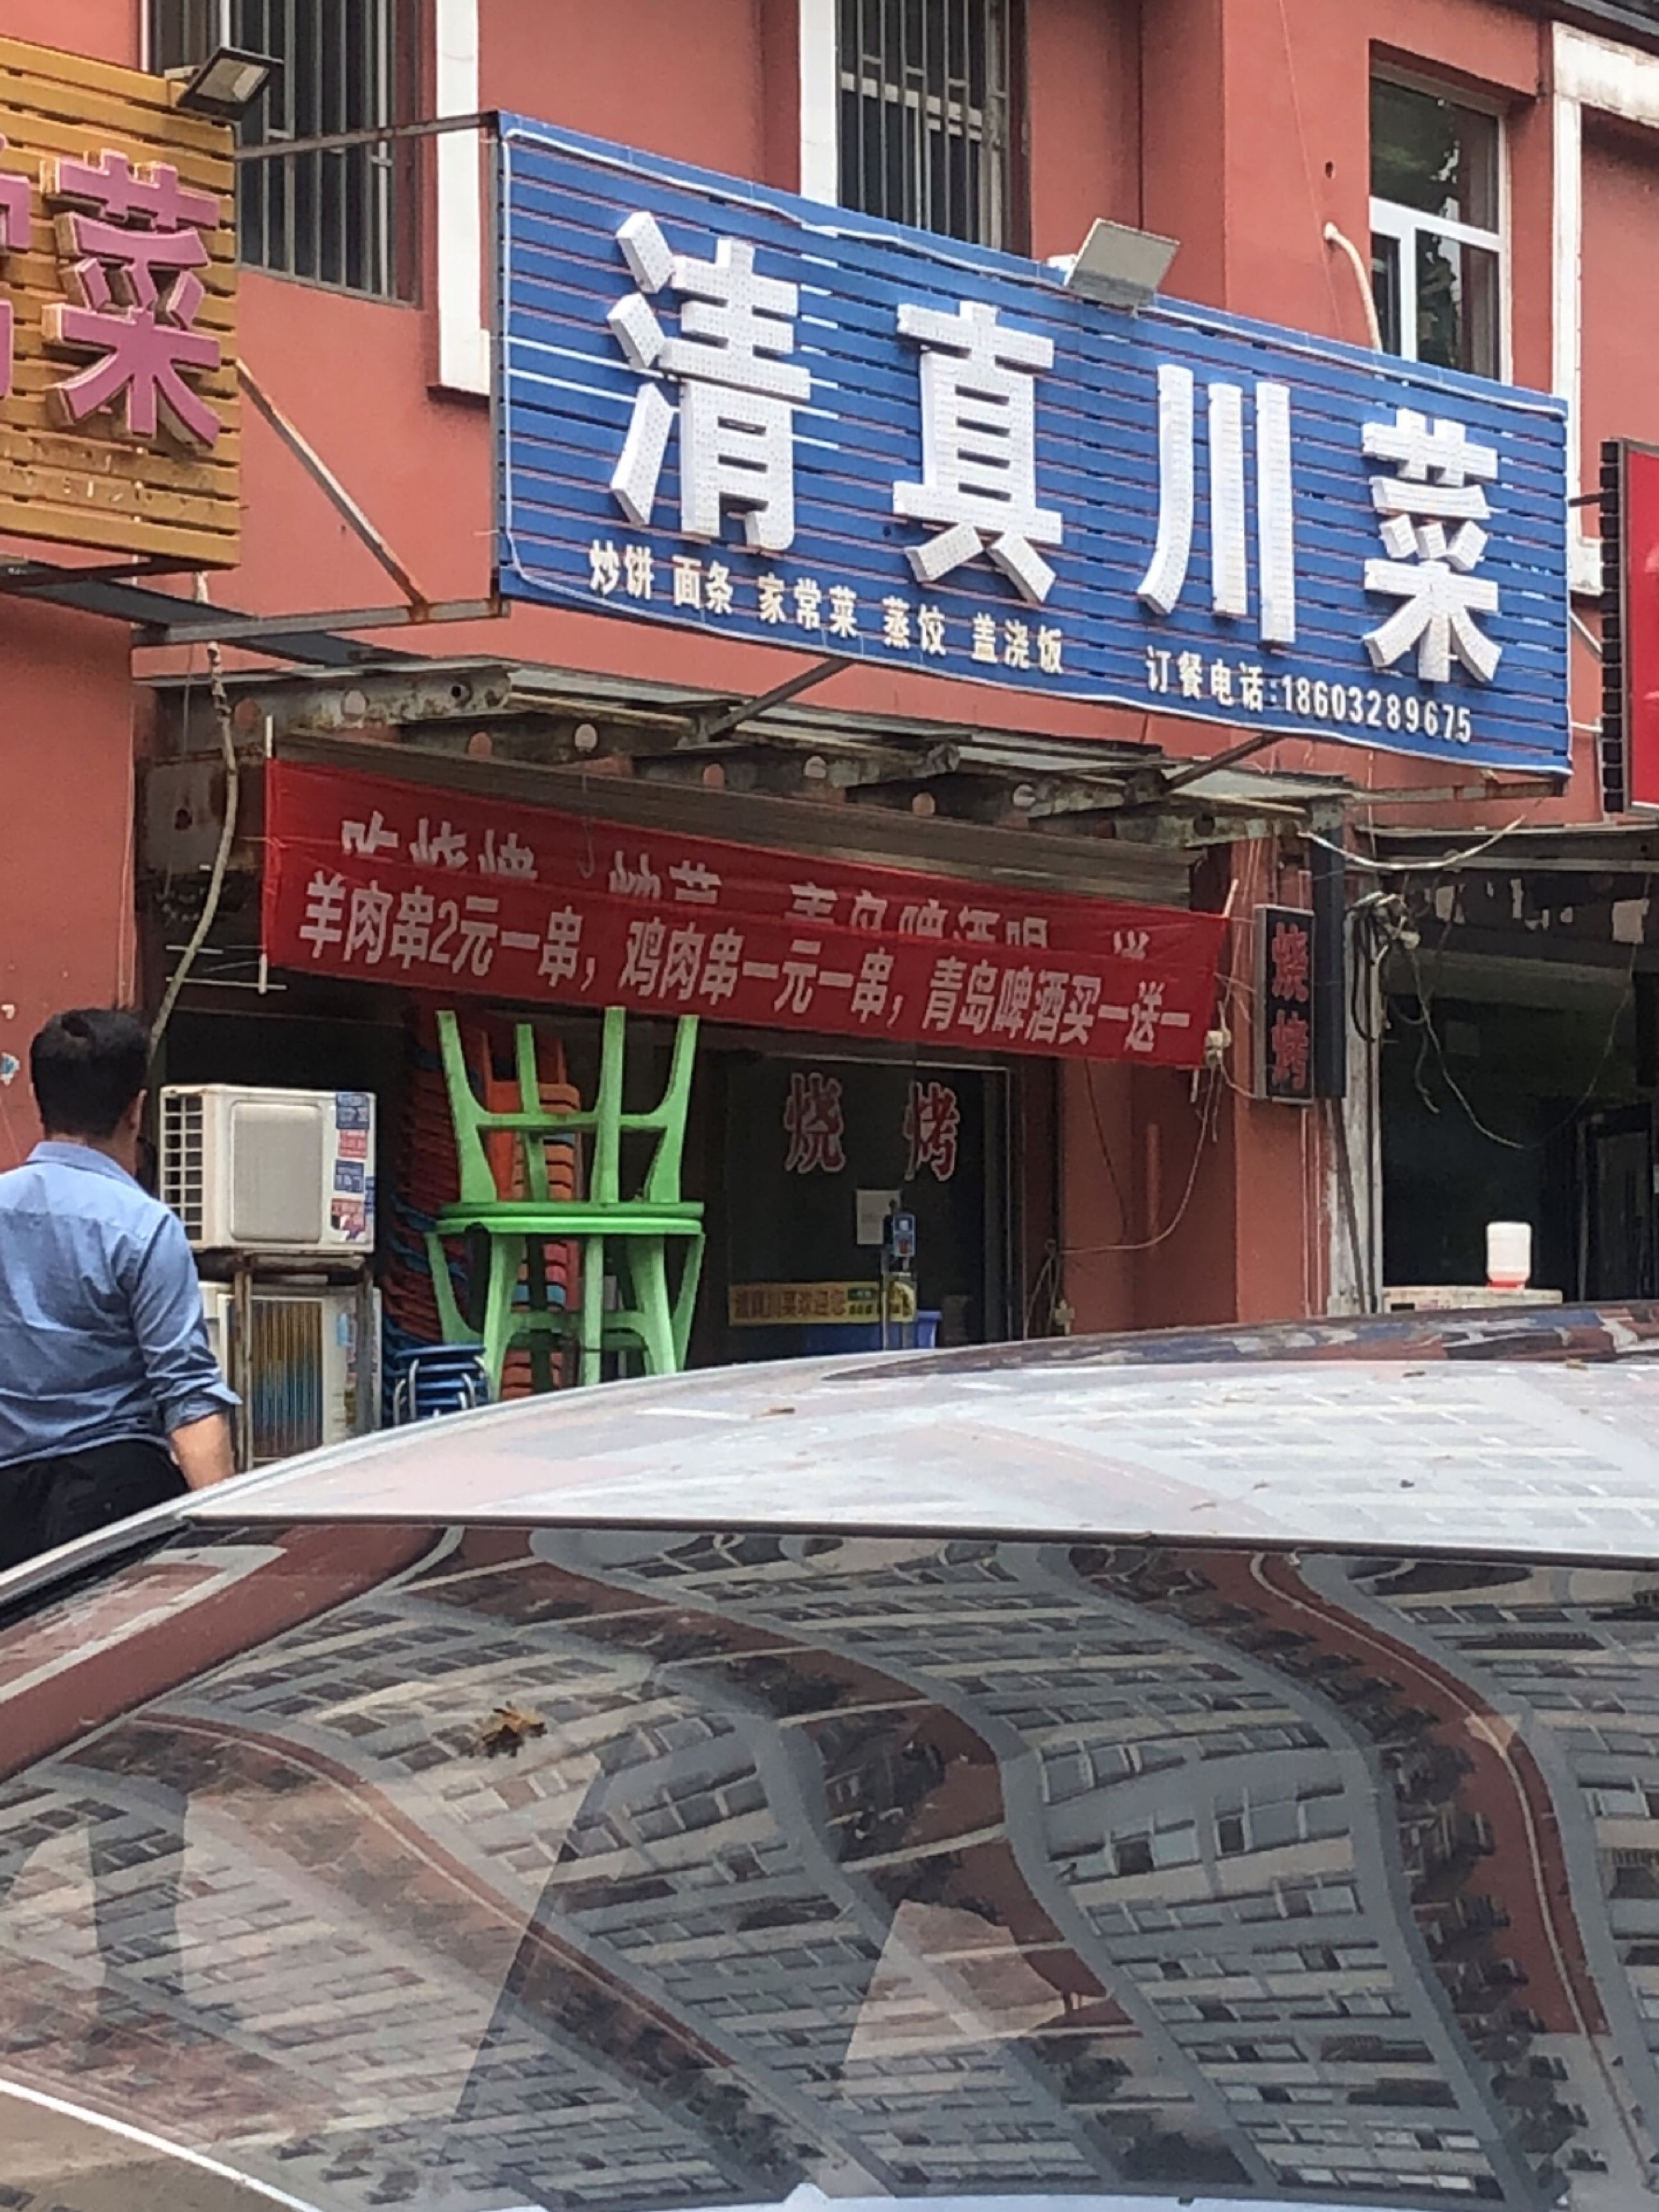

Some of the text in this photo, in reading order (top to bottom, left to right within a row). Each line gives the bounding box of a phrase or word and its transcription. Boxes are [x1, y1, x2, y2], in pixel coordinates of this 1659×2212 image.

[0, 132, 221, 450] 菜
[607, 212, 1502, 684] 清真川菜
[589, 540, 1064, 673] 炒饼 面条 家常菜 蒸饺 盖浇饭
[1272, 922, 1308, 1090] 烧烤
[783, 1072, 960, 1182] 烧烤
